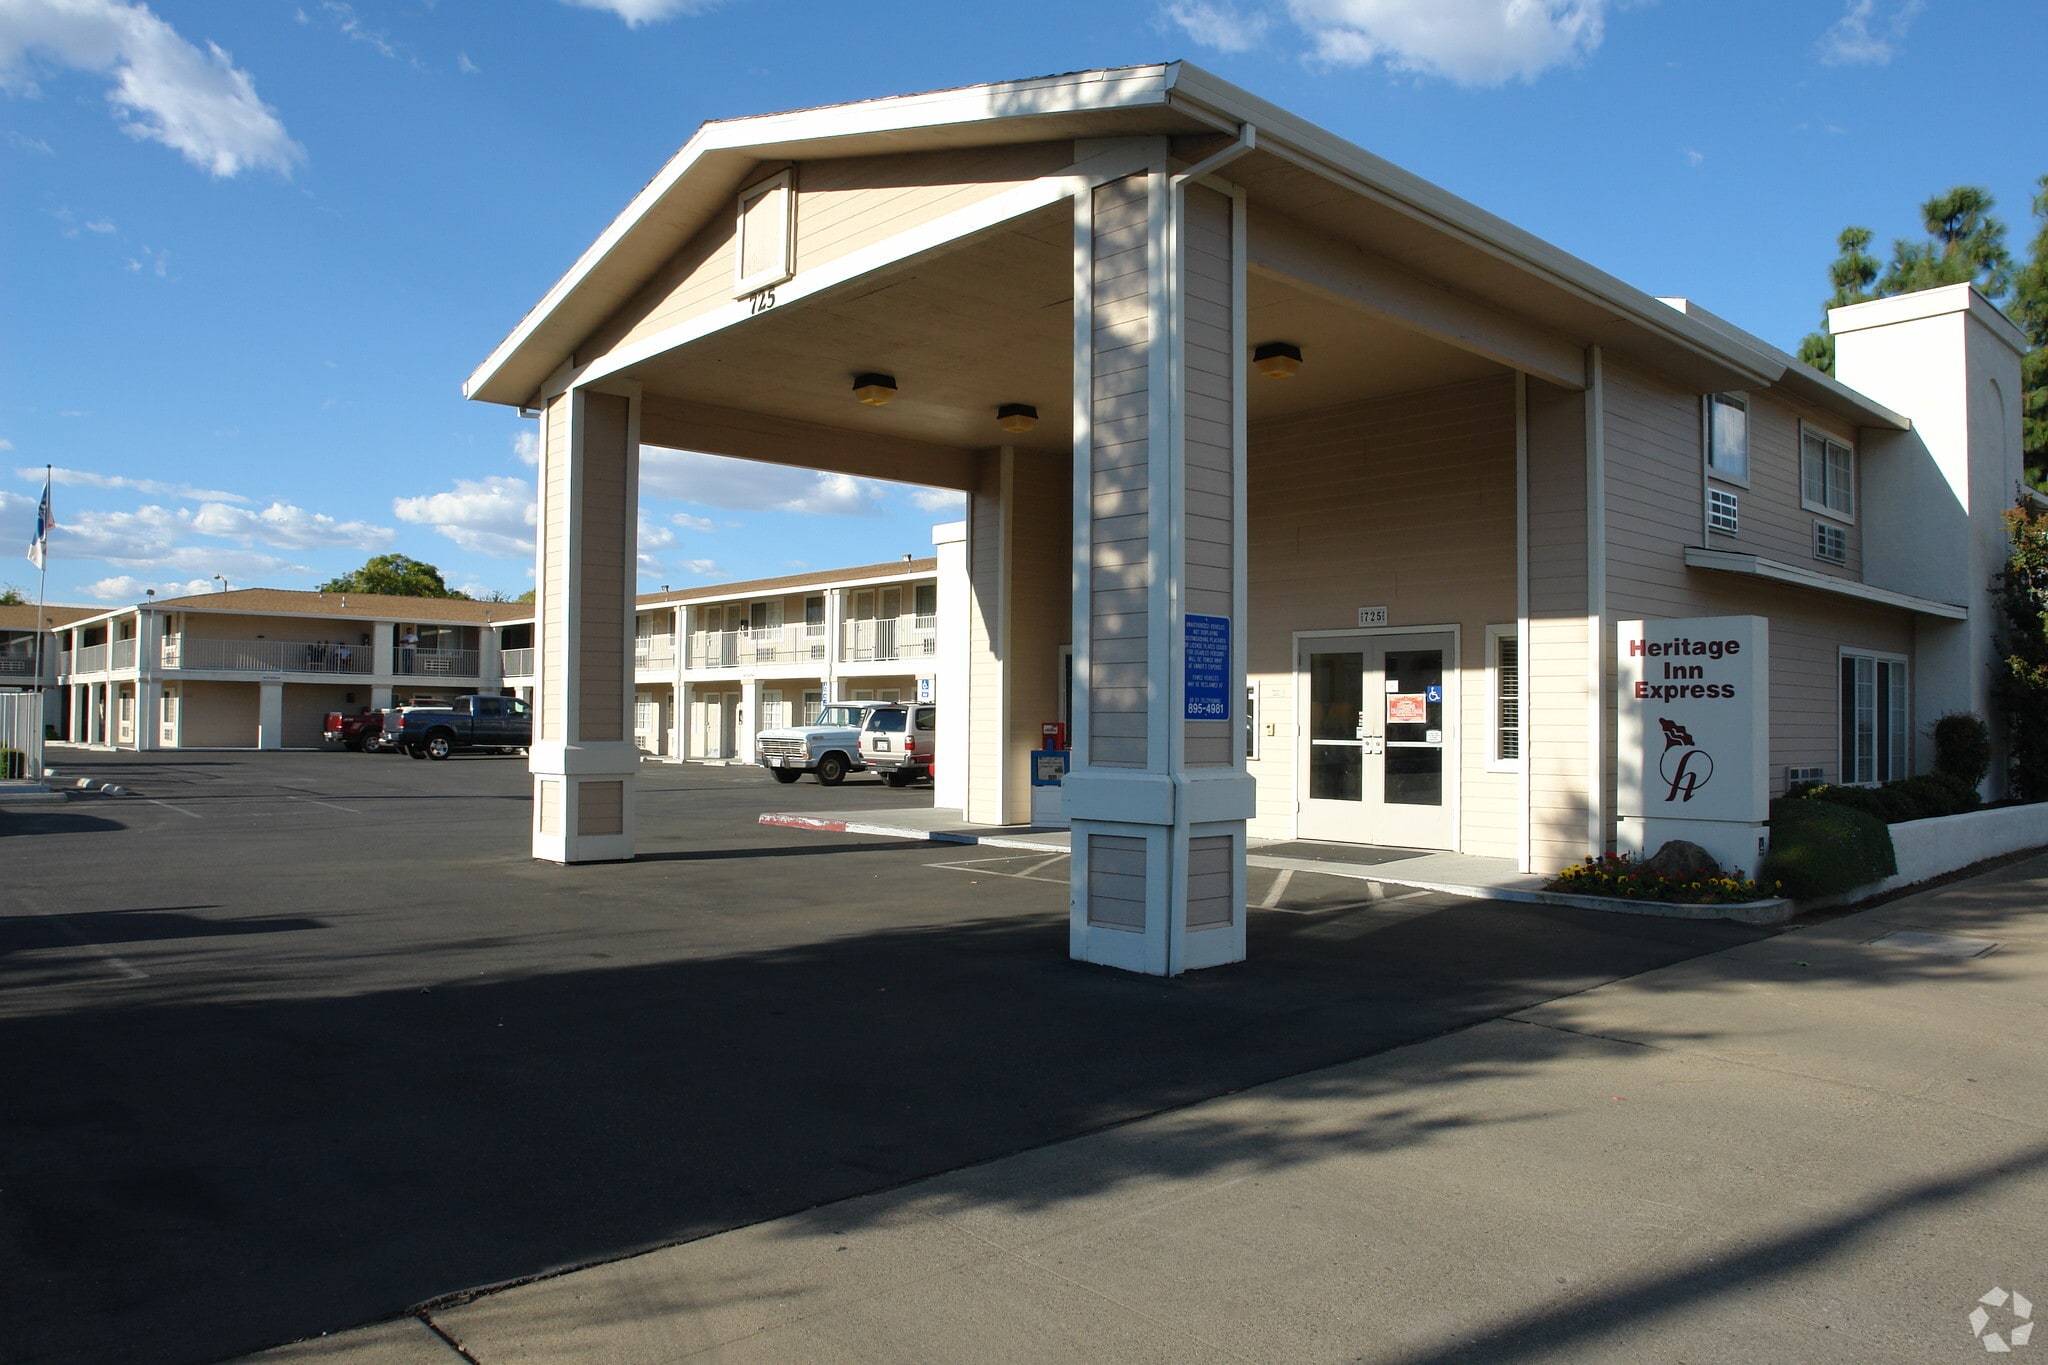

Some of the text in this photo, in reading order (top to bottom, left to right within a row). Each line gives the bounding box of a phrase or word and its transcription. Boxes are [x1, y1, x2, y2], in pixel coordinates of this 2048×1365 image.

[749, 288, 776, 315] 725
[1364, 611, 1383, 622] 725
[1629, 637, 1740, 660] Heritage
[1664, 662, 1703, 680] Inn
[1634, 681, 1736, 704] Express
[1188, 703, 1224, 714] 895-4981
